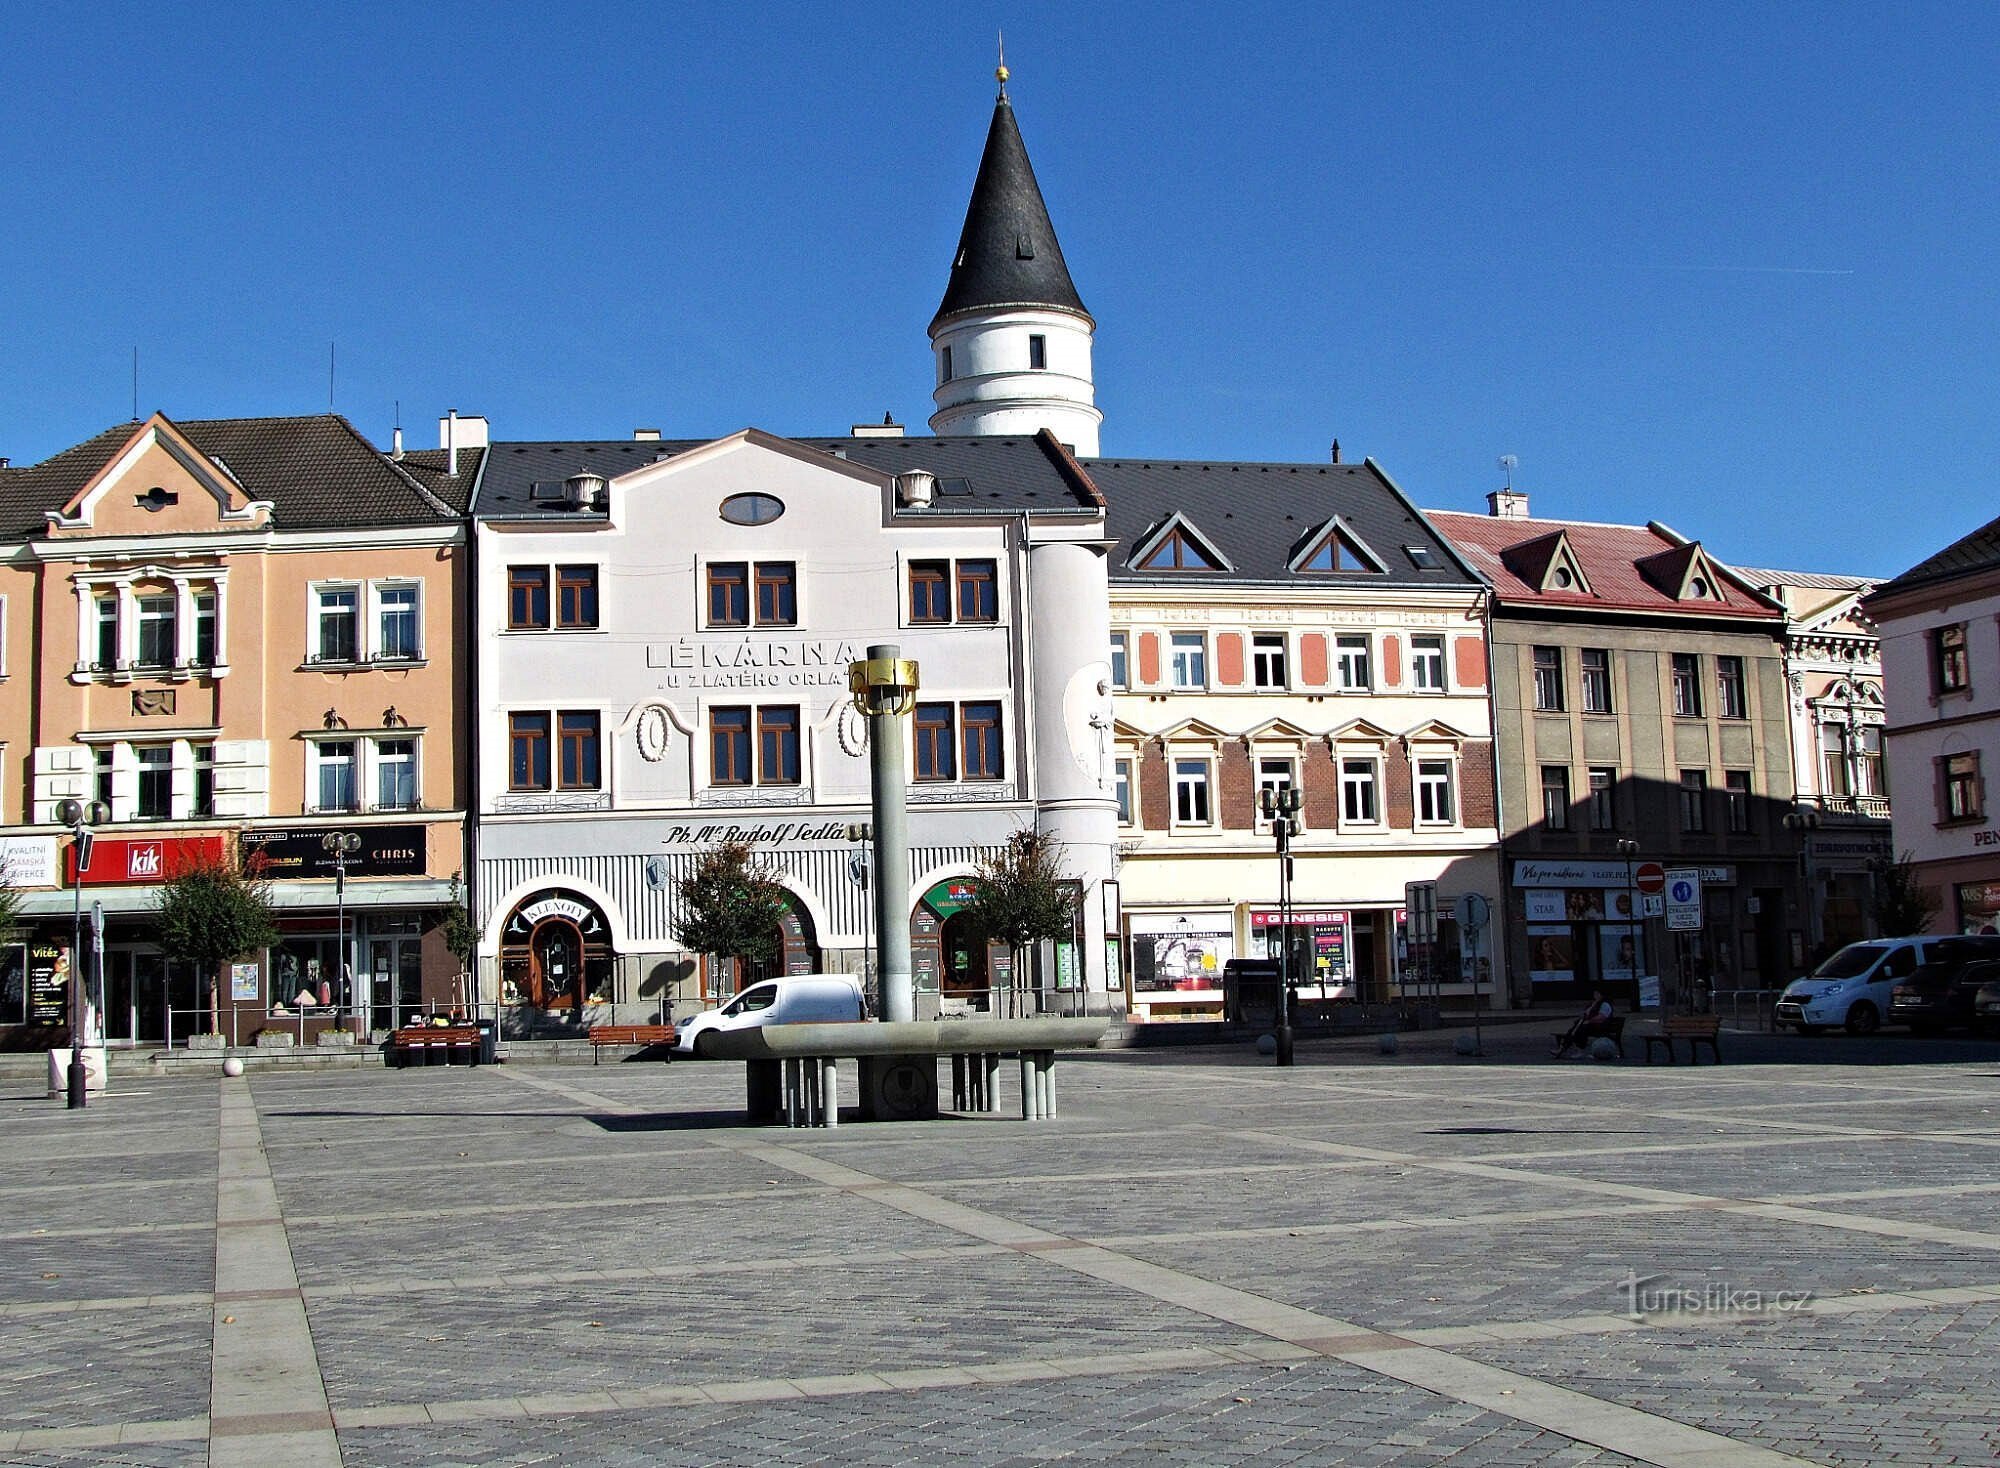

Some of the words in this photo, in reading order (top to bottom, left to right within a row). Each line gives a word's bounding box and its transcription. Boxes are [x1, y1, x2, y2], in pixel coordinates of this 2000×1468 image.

[646, 636, 859, 668] LÉKÁRNA
[688, 669, 778, 688] ZLATÉHO
[788, 823, 845, 844] Sedlá
[130, 845, 160, 873] kik
[372, 848, 415, 860] CHRIS
[527, 902, 584, 919] KLENOTY
[1267, 913, 1344, 923] GENESIS
